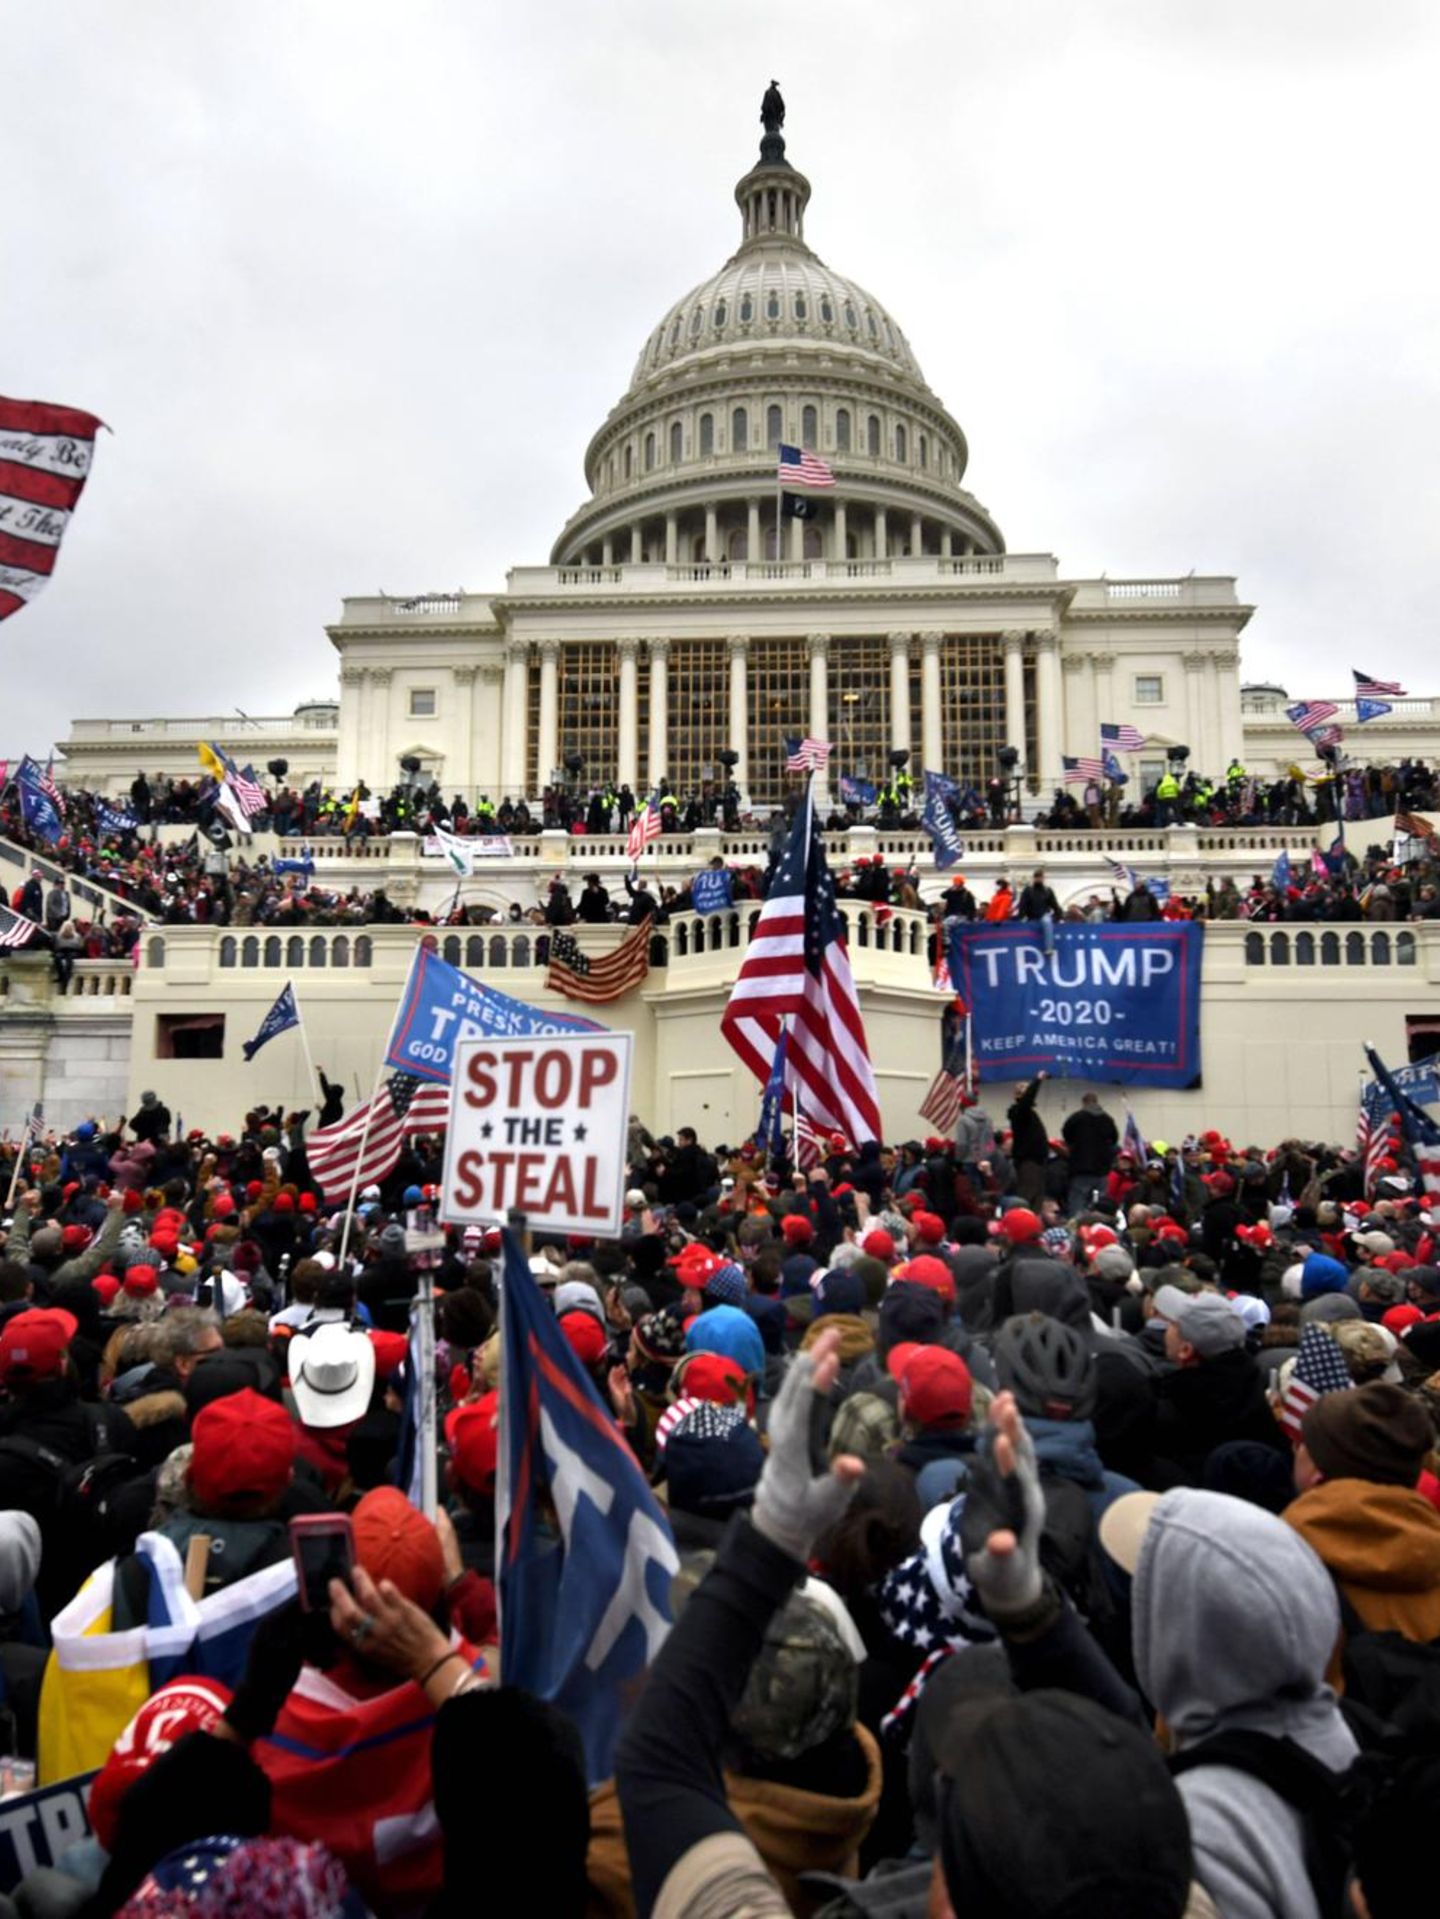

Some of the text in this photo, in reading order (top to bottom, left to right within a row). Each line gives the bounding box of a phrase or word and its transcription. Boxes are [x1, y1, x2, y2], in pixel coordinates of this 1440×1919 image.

[973, 945, 1175, 988] TRUMP
[407, 1040, 449, 1063] GOD
[981, 1033, 1177, 1055] KEEP AMERICA GREAT!
[463, 1048, 619, 1110] STOP
[503, 1117, 565, 1146] THE
[453, 1150, 611, 1220] STEAL
[0, 1784, 94, 1878] TR
